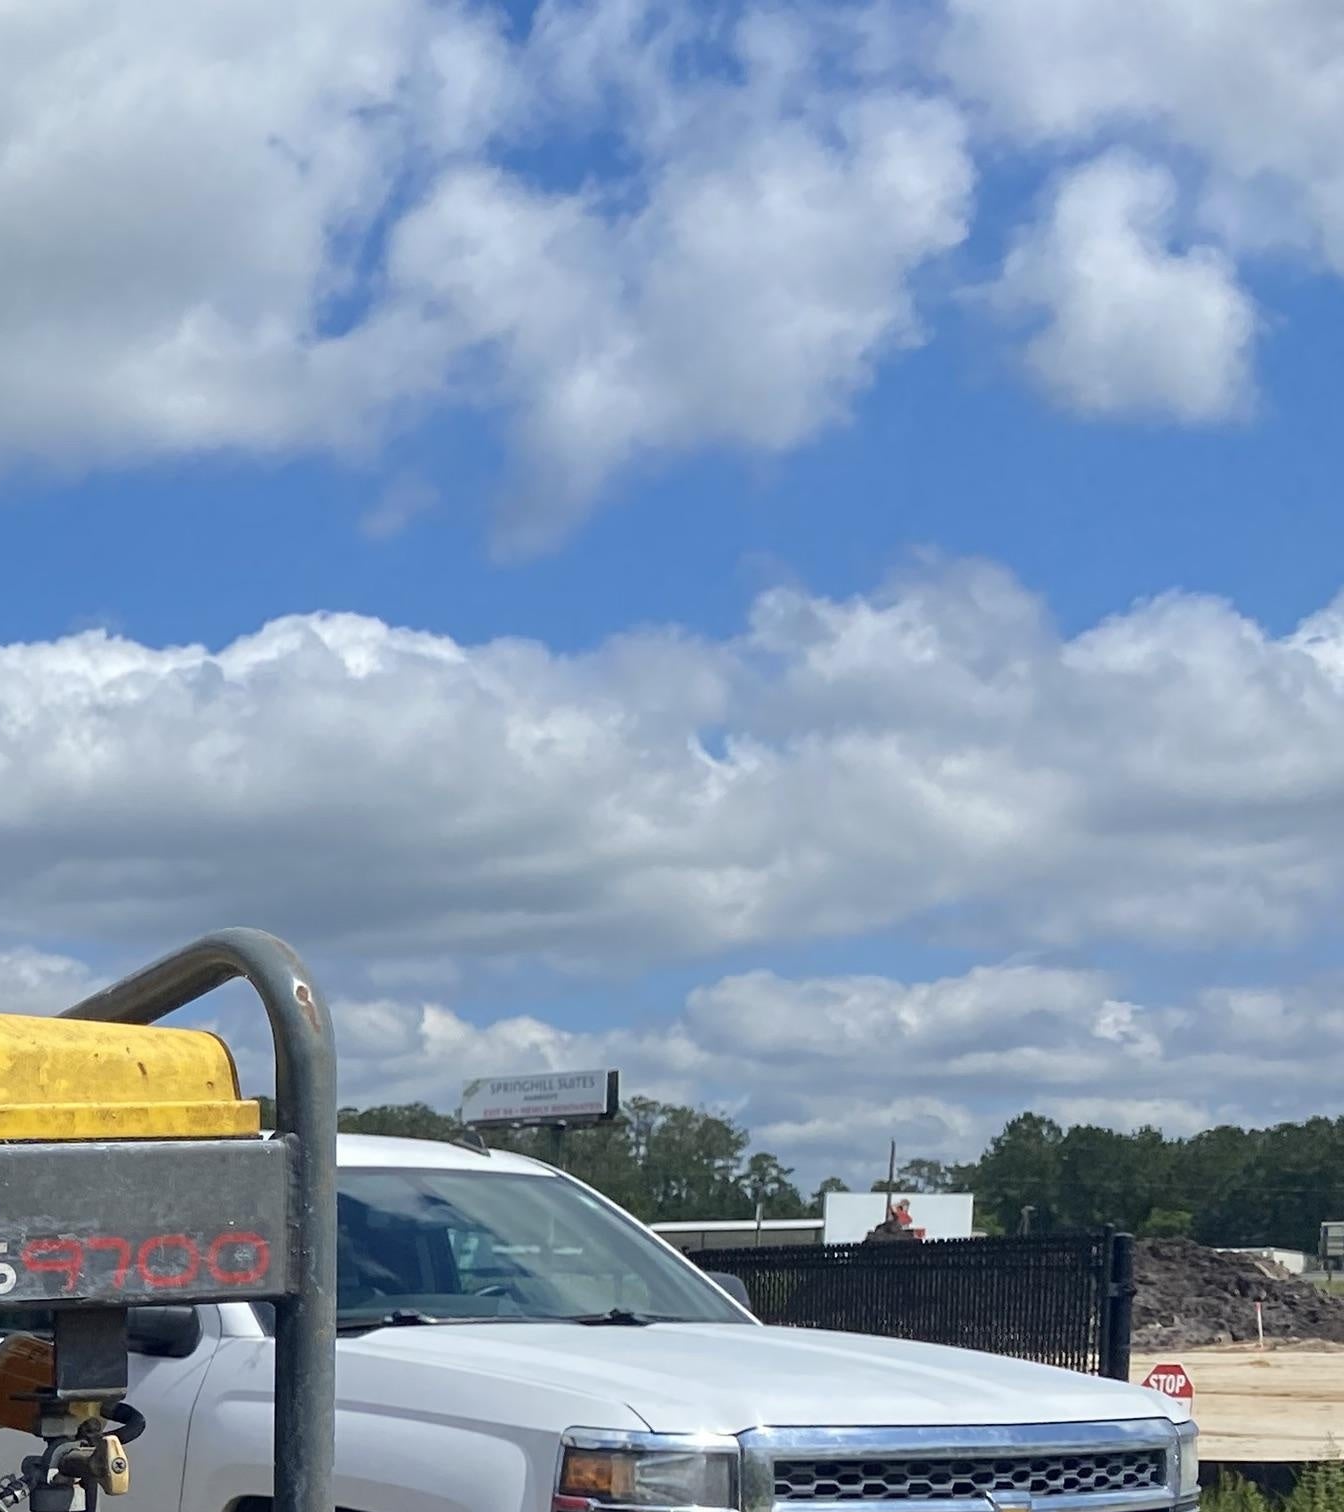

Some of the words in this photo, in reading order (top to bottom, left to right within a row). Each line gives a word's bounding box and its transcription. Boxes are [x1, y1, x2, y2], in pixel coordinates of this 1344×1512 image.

[489, 1079, 554, 1095] SPRINGHILL
[558, 1076, 596, 1089] SUITES
[1148, 1374, 1186, 1394] STOP
